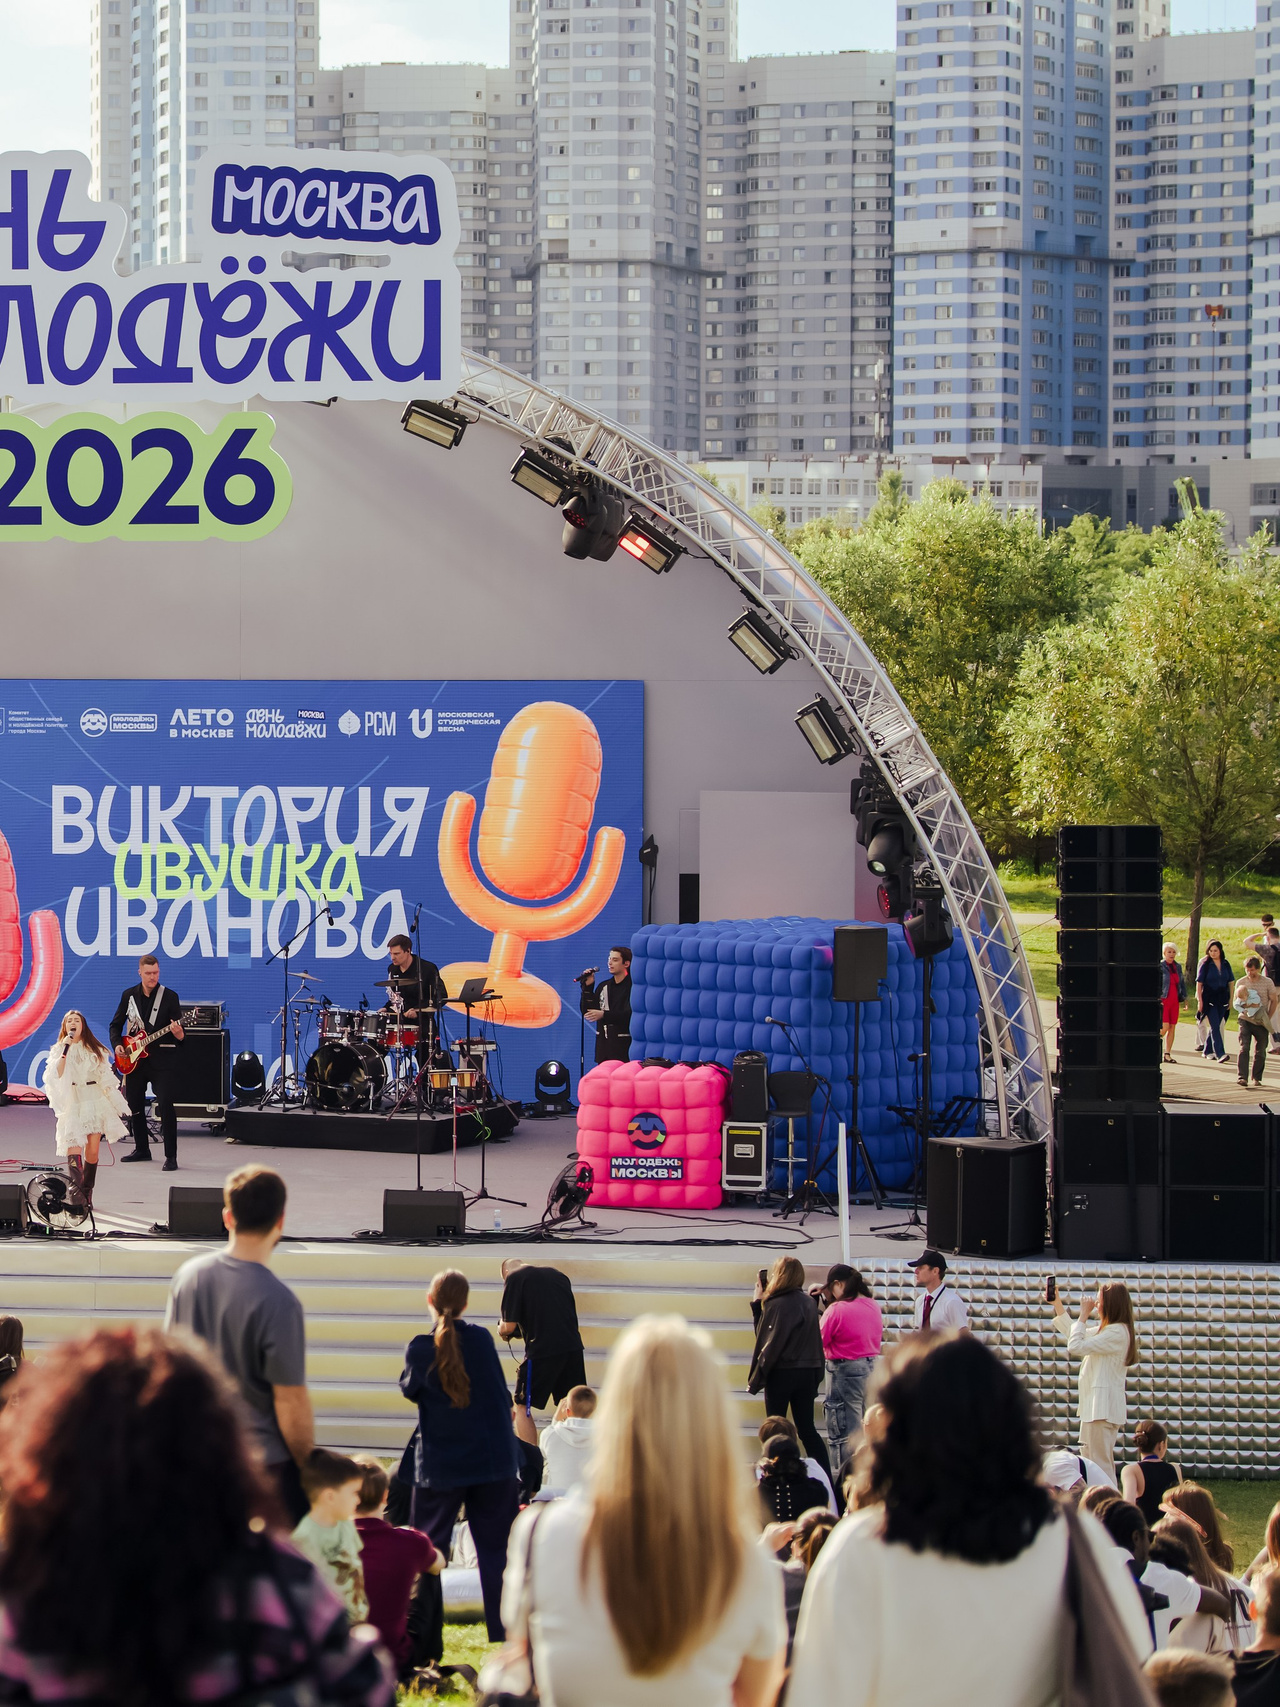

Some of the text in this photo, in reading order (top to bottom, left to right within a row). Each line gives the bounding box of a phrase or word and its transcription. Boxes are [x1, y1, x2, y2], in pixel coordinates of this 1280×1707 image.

[222, 174, 431, 235] МОСКВА
[169, 708, 234, 726] ЛЕТО
[297, 710, 325, 719] МОСКВА
[364, 711, 397, 736] РСМ
[169, 728, 234, 738] В МОСКВЕ
[50, 784, 430, 857] ВИКТОРИЯ
[113, 843, 365, 902] ИВУШКА
[64, 887, 411, 960] ИВАНОВА
[611, 1156, 682, 1167] МОЛОДЁЖЬ
[611, 1167, 682, 1179] МОСКВЫ
